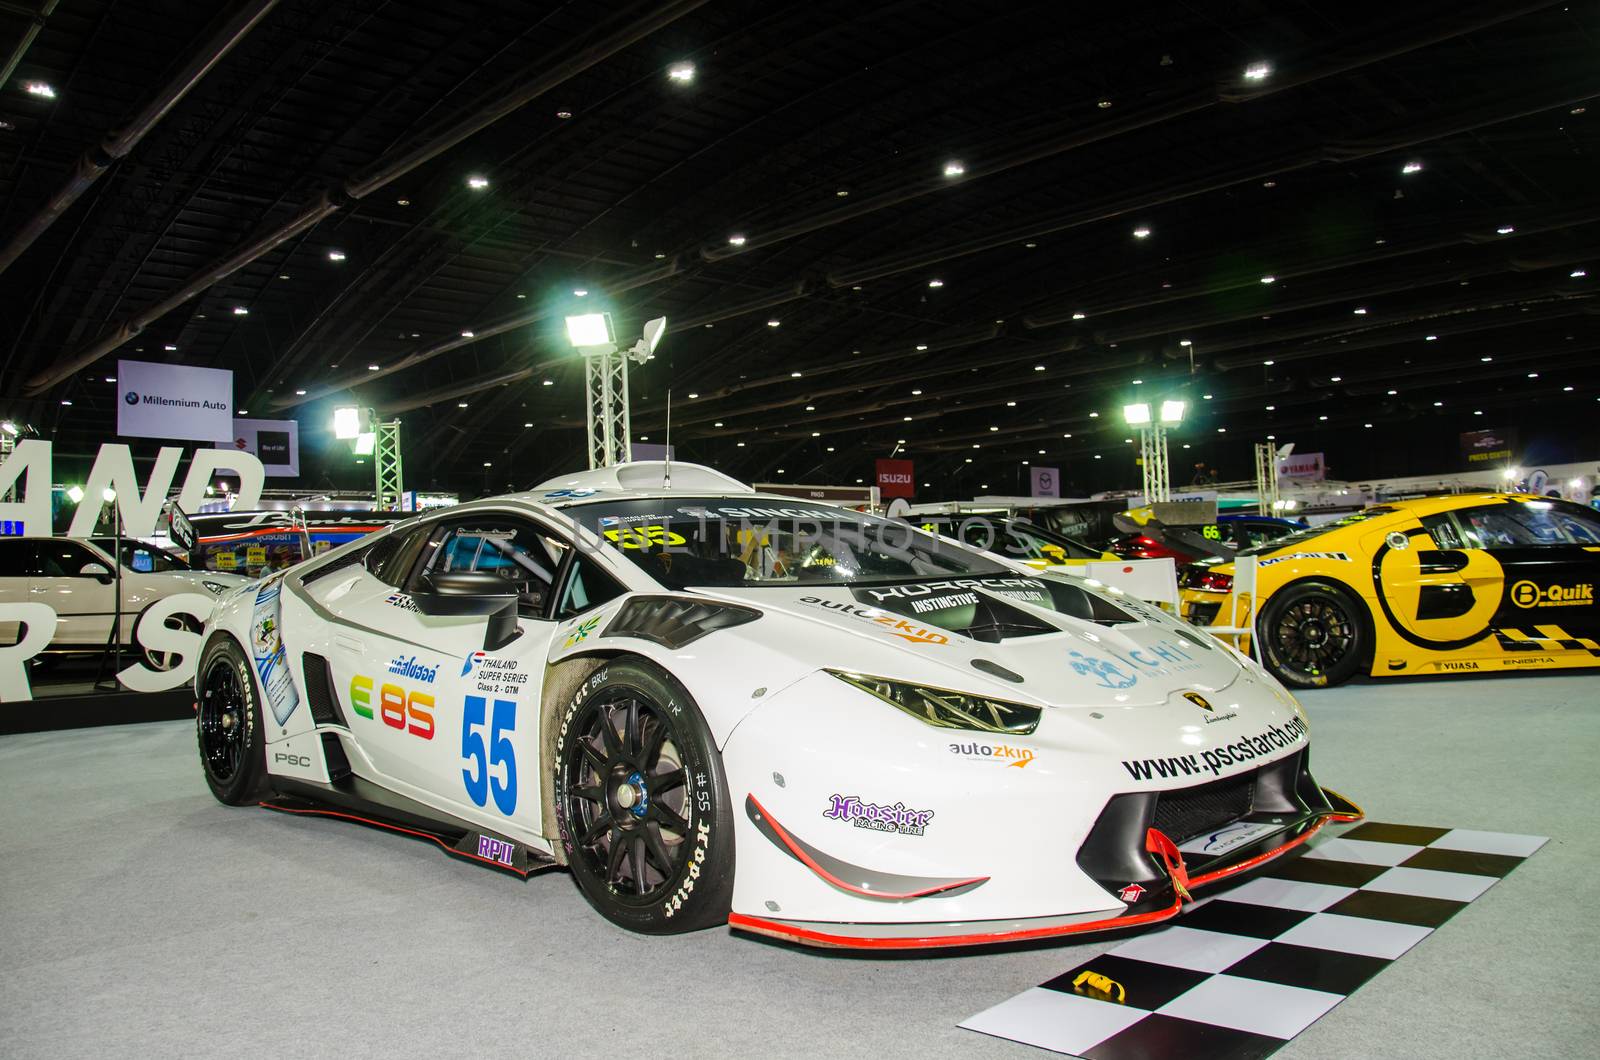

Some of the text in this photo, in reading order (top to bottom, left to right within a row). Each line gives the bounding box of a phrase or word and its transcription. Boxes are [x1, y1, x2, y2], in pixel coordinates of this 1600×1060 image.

[143, 395, 227, 411] Millennium Auto
[880, 474, 911, 483] ISUZU
[604, 525, 686, 549] 55
[1203, 526, 1218, 540] 66
[1259, 552, 1320, 567] Mobil
[911, 592, 980, 614] INSTINCTIVE
[799, 595, 950, 645] autozkin
[482, 659, 518, 670] THAILAND
[1444, 662, 1480, 670] YUASA
[478, 670, 528, 684] SUPER SERIES
[477, 682, 493, 692] Class
[494, 685, 499, 693] 2
[505, 685, 519, 694] GTM
[1203, 711, 1237, 725] Lamborghini
[461, 695, 517, 816] 55
[949, 742, 1034, 761] autozkin
[1122, 714, 1308, 781] www.pscstarch.com
[274, 752, 311, 768] PSC
[823, 794, 934, 827] Hoosier
[855, 818, 923, 836] RACING TIRE
[664, 818, 711, 918] Hoosier
